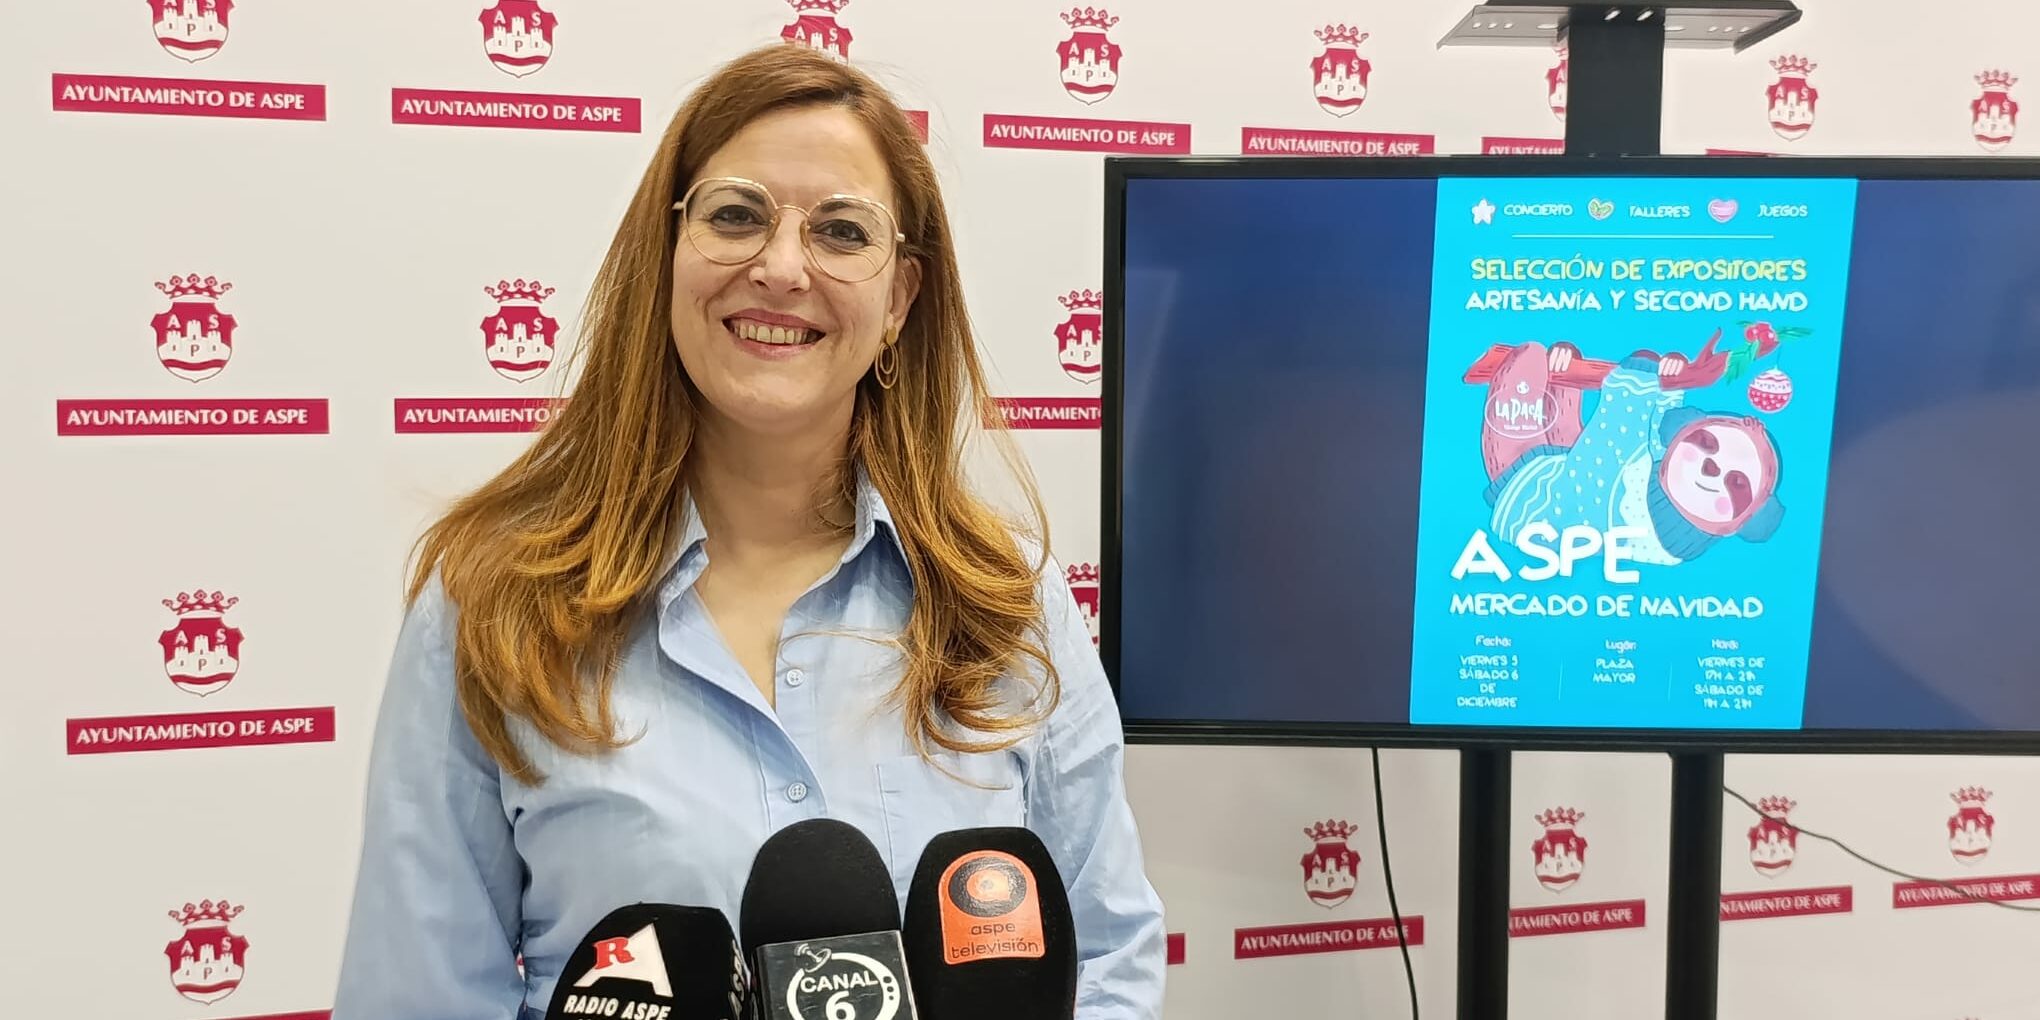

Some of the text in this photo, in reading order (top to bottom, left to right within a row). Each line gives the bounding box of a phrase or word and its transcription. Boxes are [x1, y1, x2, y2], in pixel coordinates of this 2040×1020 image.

[62, 84, 305, 110] AYUNTAMIENTO DE ASPE
[401, 99, 622, 122] AYUNTAMIENTO DE ASPE
[990, 123, 1175, 146] AYUNTAMIENTO DE ASPE
[1248, 136, 1362, 154] AYUNTAMIENTO
[1366, 142, 1384, 155] DE
[1504, 204, 1808, 218] CONCIERTO TALLERES JUEGOS
[1471, 253, 1807, 282] SELECCIÓN DE EXPOSITORES
[1465, 288, 1808, 312] ARTESANÍA Y SECOND HAND
[67, 408, 308, 426] AYUNTAMIENTO DE ASPE
[403, 407, 549, 423] AYUNTAMIENTO
[1450, 521, 1646, 583] ASPE
[1450, 593, 1764, 619] MERCADO DE NAVIDAD
[1460, 655, 1508, 666] VIERNES
[1596, 658, 1634, 669] PLAZA
[1697, 656, 1765, 668] VIERNES DE
[1459, 667, 1509, 680] SÁBADO
[1593, 672, 1636, 683] MAYOR
[1479, 683, 1496, 694] DE
[1747, 684, 1764, 696] DE
[1457, 696, 1518, 707] DICIEMBRE
[76, 717, 314, 745] AYUNTAMIENTO DE ASPE
[1794, 895, 1811, 910] DE
[1583, 910, 1600, 925] DE
[1603, 908, 1632, 923] ASPE
[971, 923, 1015, 936] aspe
[1240, 929, 1352, 950] AYUNTAMIENTO
[1356, 927, 1374, 942] DE
[593, 936, 635, 970] R
[951, 937, 1039, 959] televisión
[800, 970, 879, 993] CANAL
[563, 994, 671, 1020] RADIO ASPE
[825, 990, 856, 1020] 6
